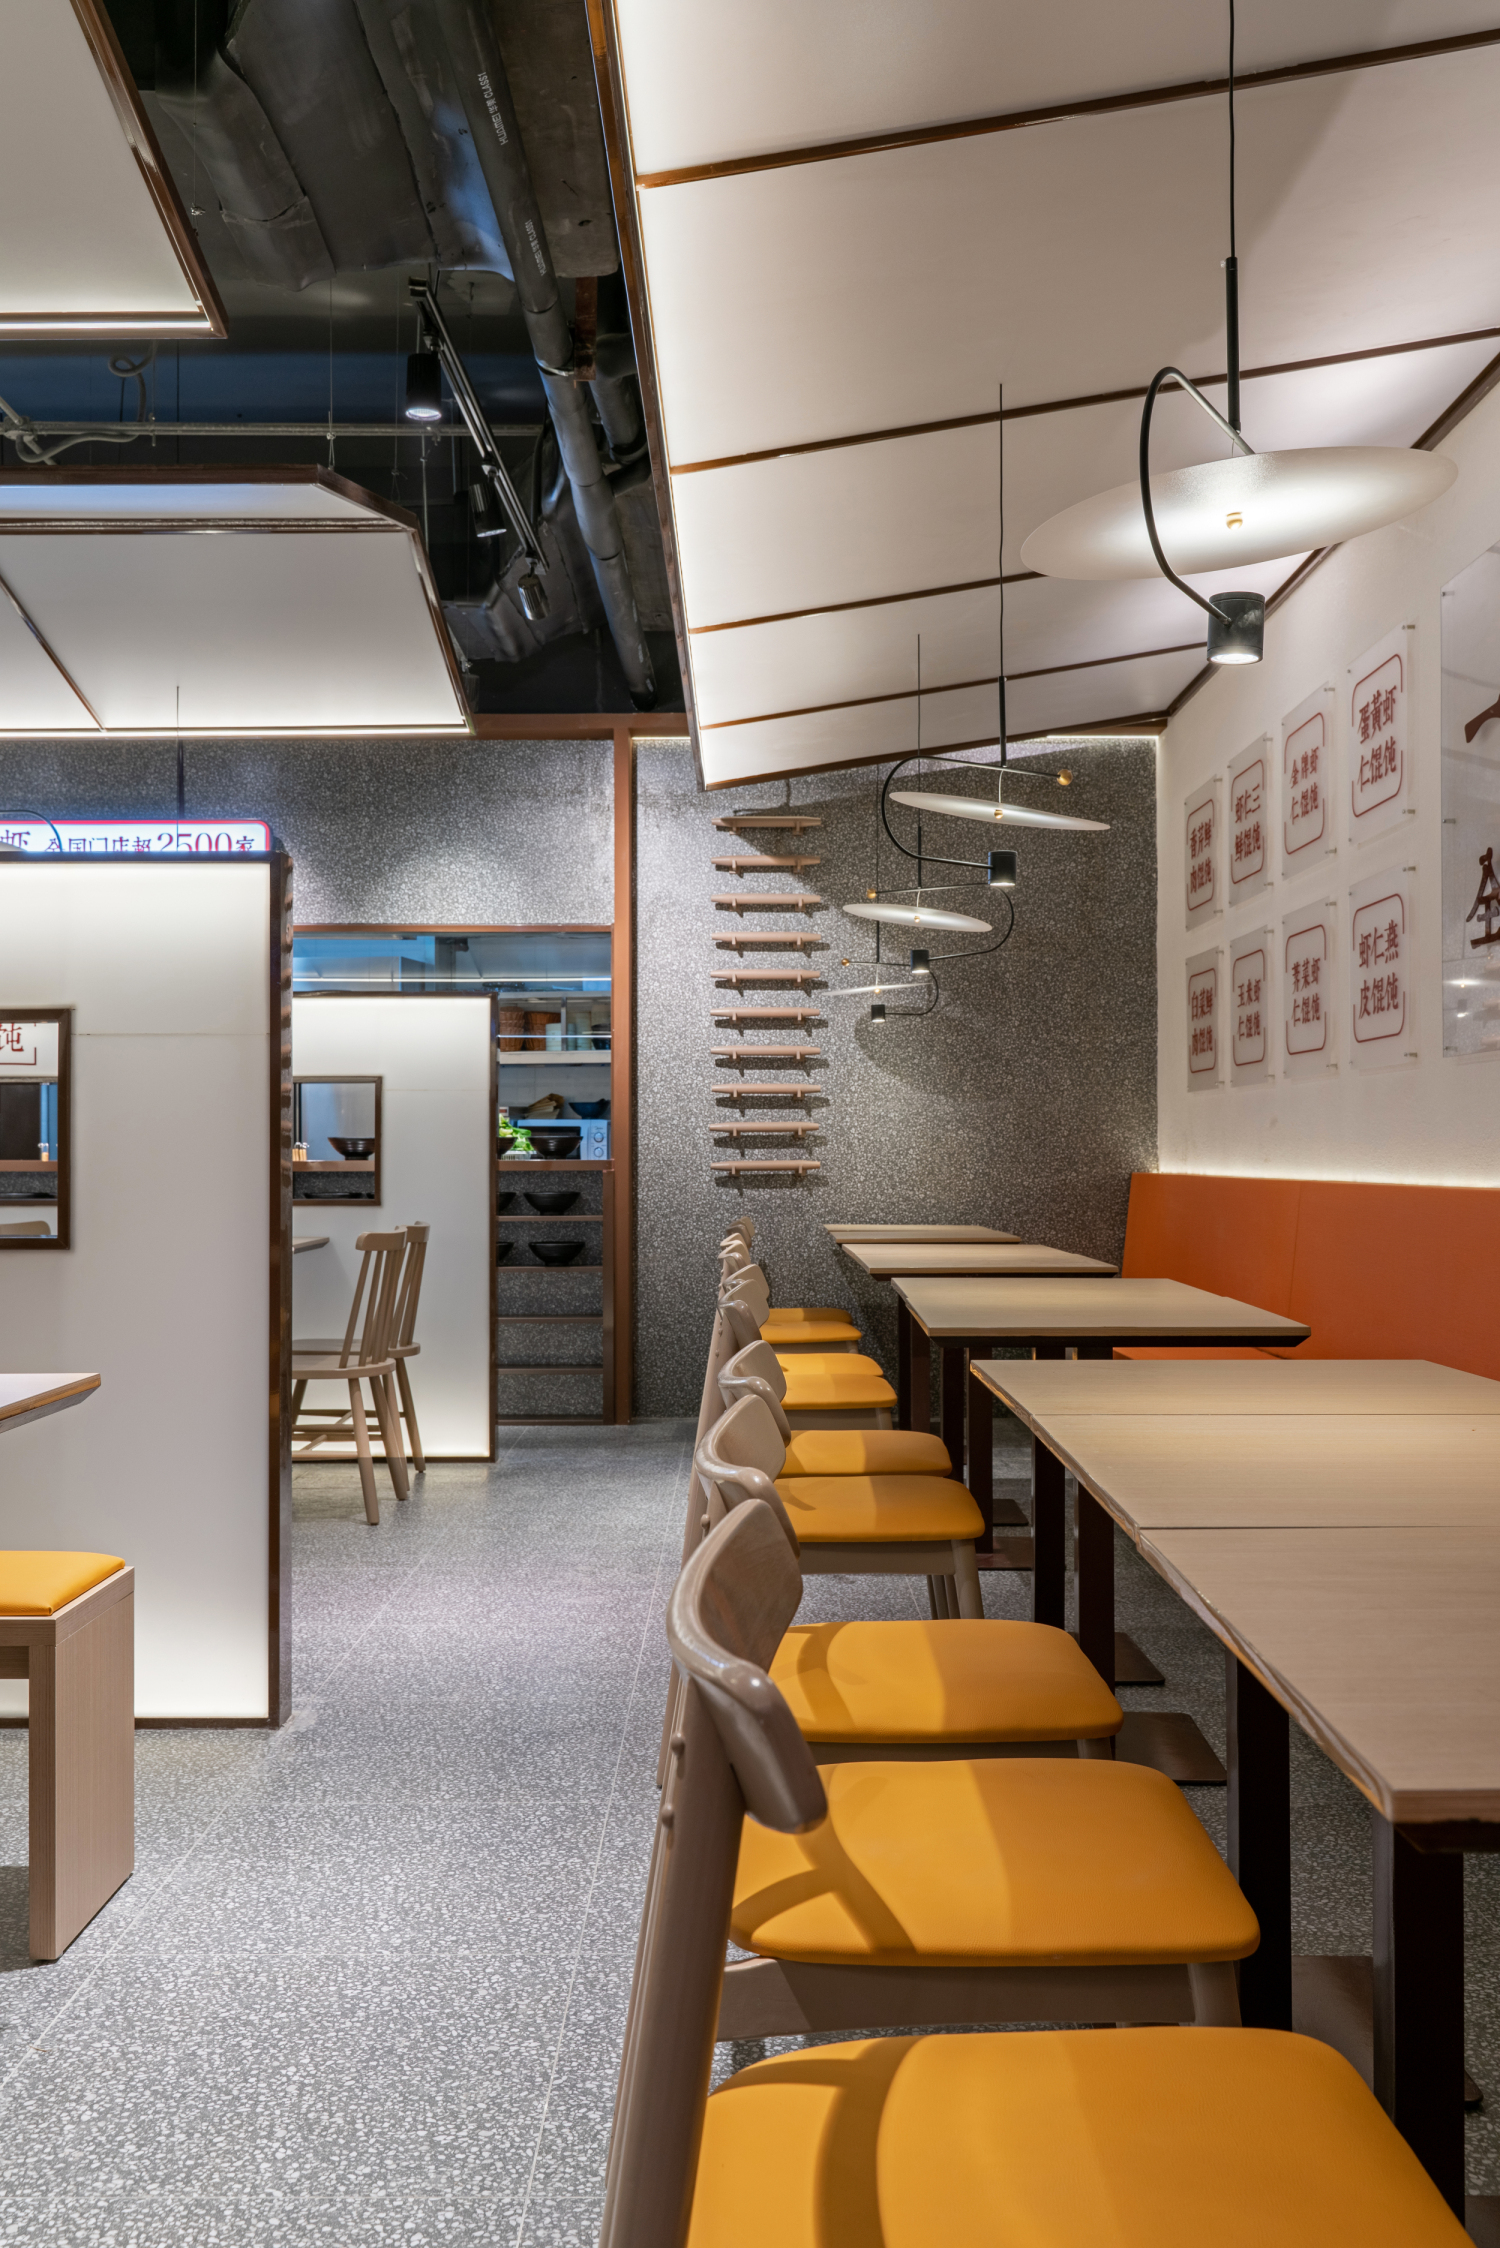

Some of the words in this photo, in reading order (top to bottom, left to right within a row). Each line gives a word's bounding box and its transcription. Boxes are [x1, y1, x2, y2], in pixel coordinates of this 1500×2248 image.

[477, 71, 494, 99] CLASS1
[1290, 746, 1319, 789] 金牌虾
[1357, 735, 1397, 793] 仁馄饨
[1235, 783, 1260, 823] 虾仁三
[1290, 782, 1319, 825] 仁馄饨
[1359, 919, 1399, 968] 虾仁燕
[1237, 978, 1261, 1008] 玉米虾
[1291, 993, 1320, 1027] 仁馄饨
[1358, 972, 1399, 1019] 皮馄饨
[1237, 1010, 1261, 1041] 仁馄饨
